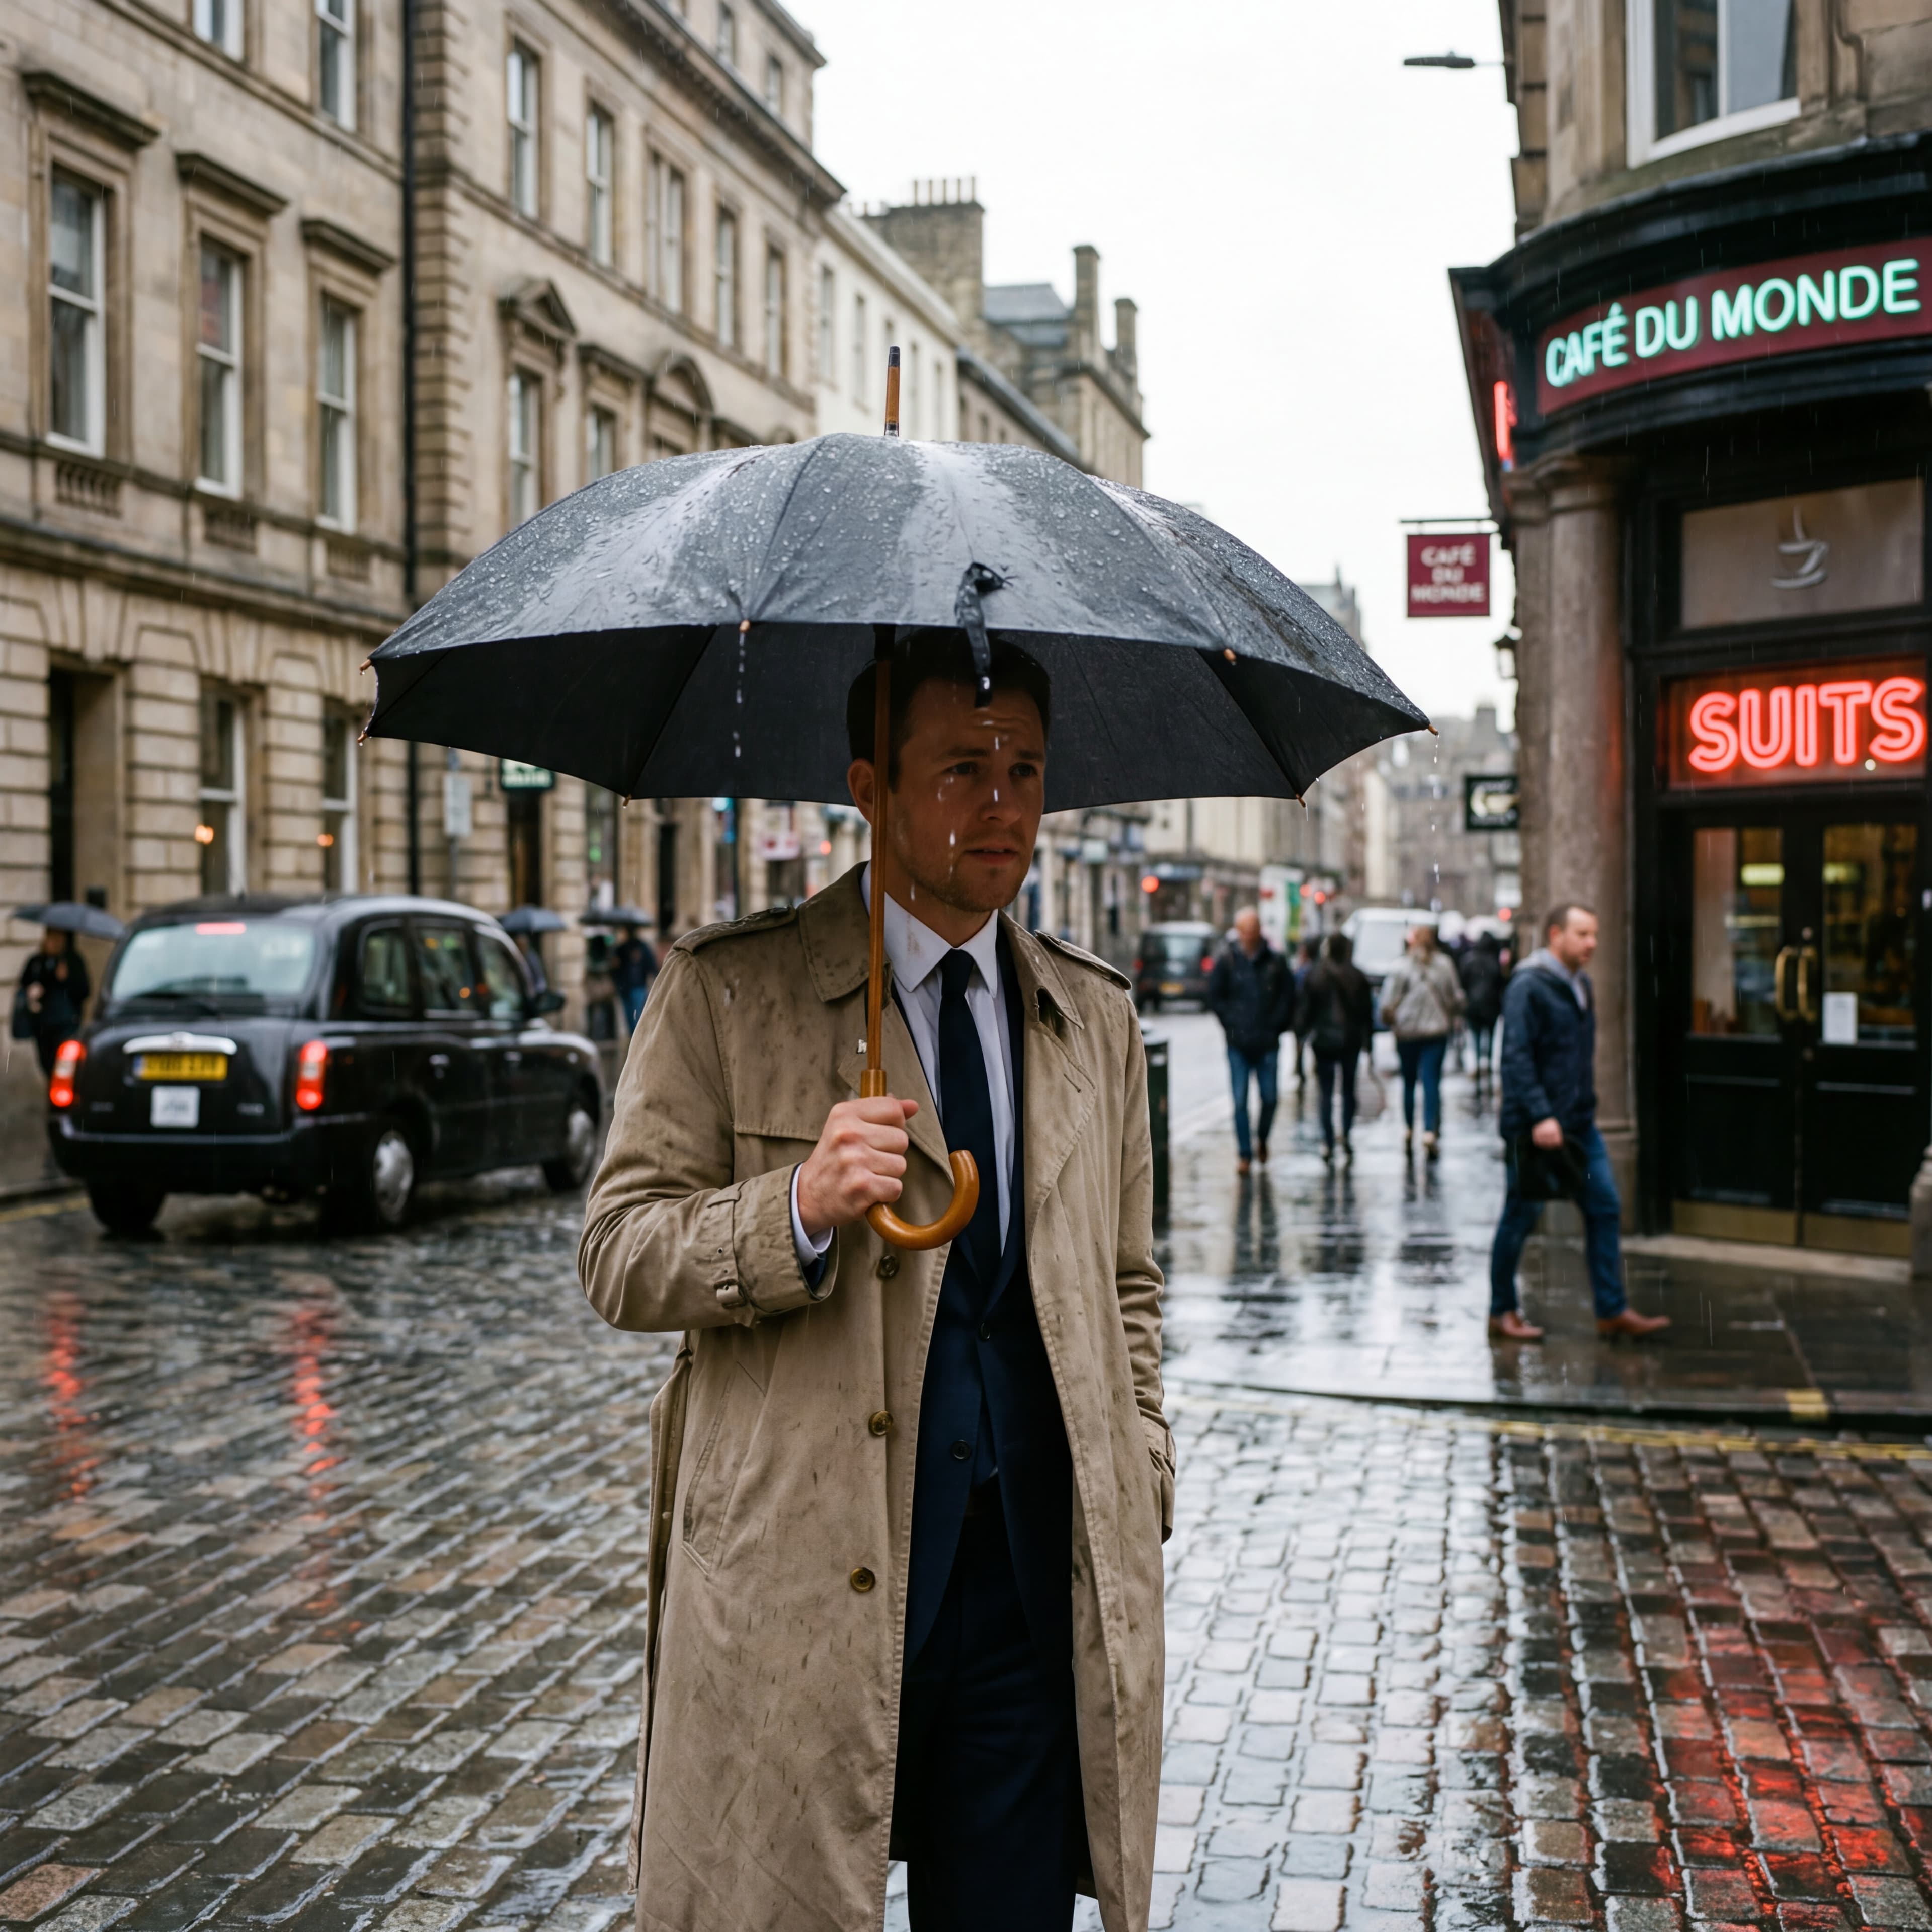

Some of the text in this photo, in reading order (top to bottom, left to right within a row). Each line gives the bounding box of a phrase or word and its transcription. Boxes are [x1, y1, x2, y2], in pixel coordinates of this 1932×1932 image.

[1546, 258, 1921, 387] CAFÉ DU MONDE
[1688, 677, 1927, 772] SUITS
